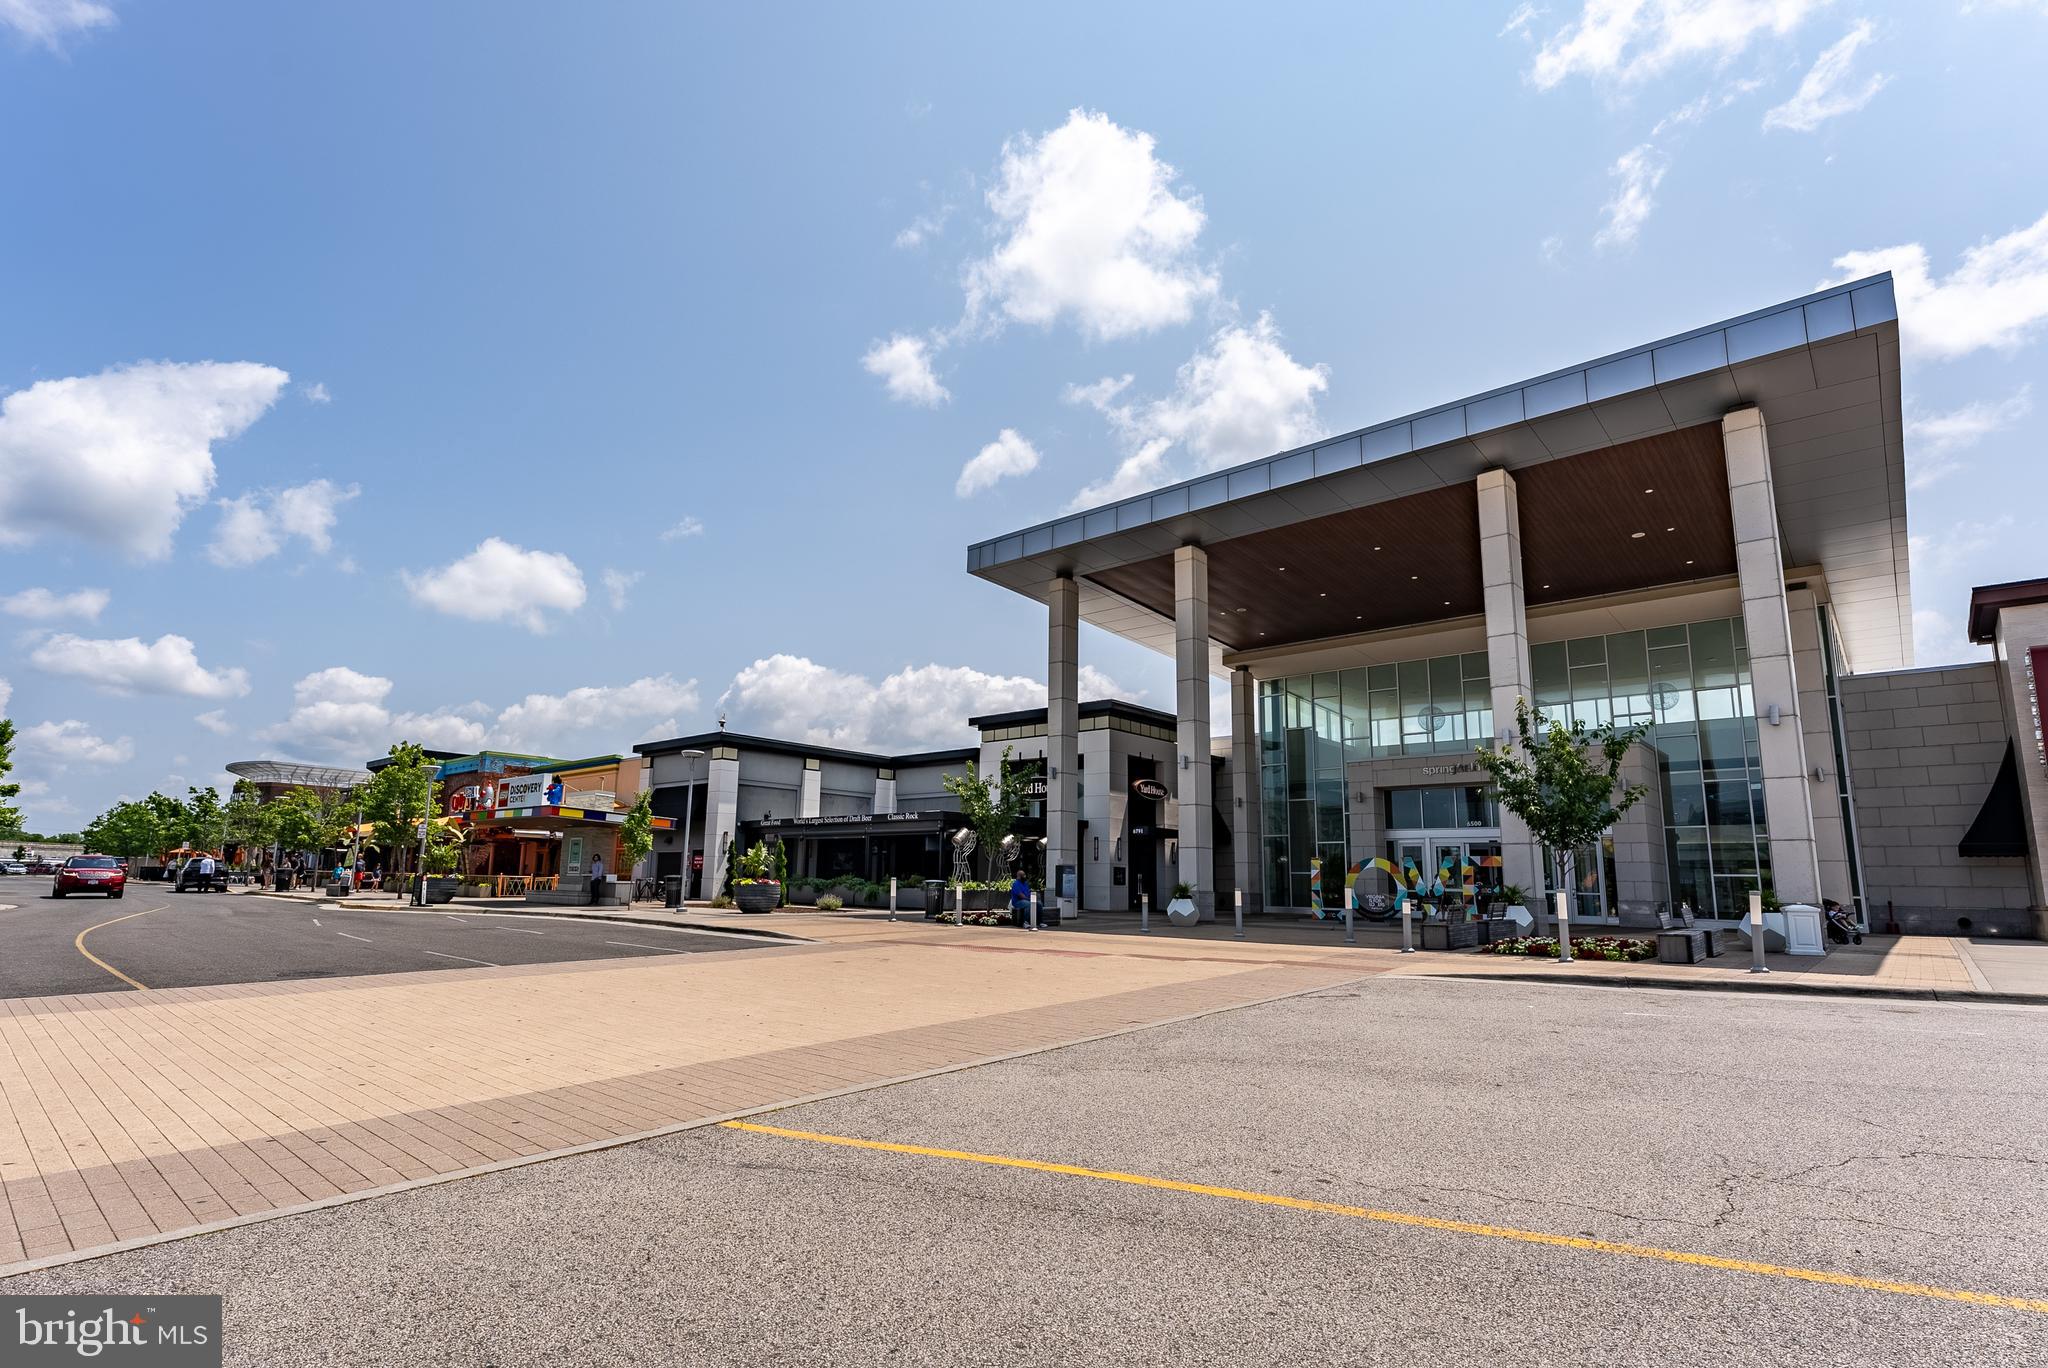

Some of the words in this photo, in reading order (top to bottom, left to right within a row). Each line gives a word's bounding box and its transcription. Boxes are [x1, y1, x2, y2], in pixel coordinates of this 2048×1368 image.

[510, 782, 542, 795] DISCOVERY
[1140, 784, 1150, 794] Yard
[1151, 786, 1165, 796] House
[809, 818, 823, 826] Largest
[905, 811, 919, 820] Rock
